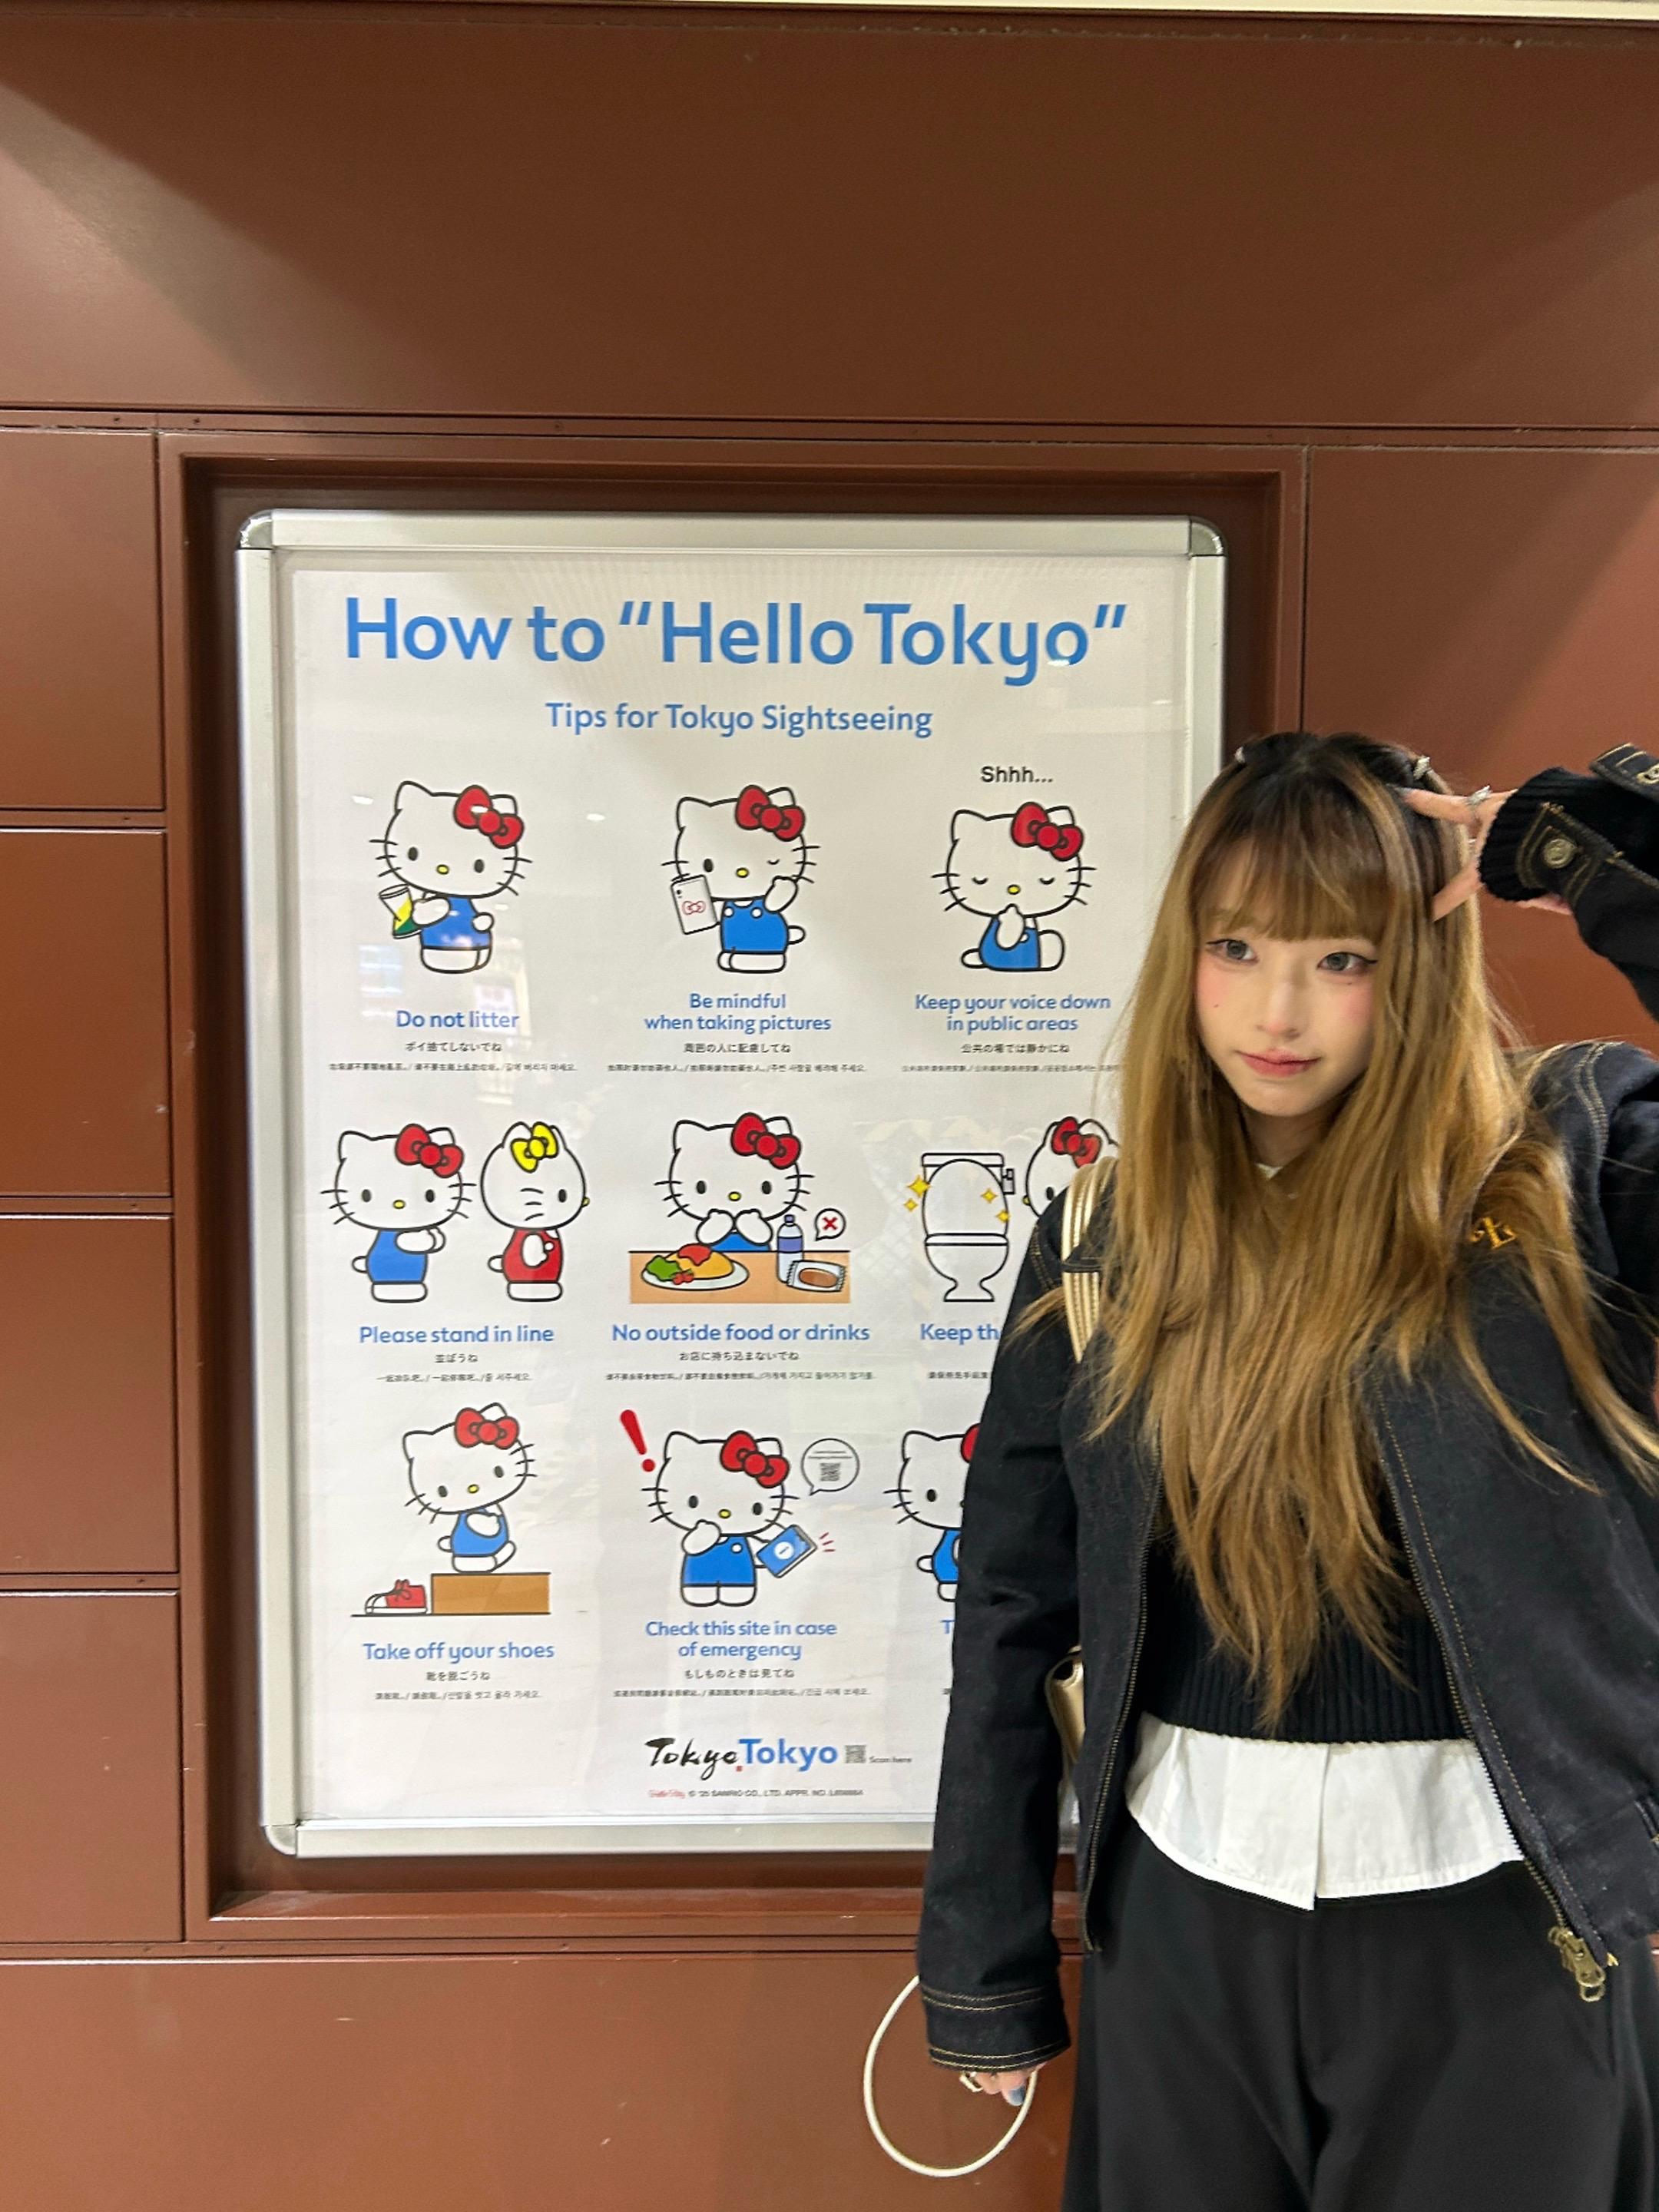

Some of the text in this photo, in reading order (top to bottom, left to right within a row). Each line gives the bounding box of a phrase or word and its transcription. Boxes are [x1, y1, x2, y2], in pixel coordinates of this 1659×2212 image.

[345, 597, 512, 661] How
[528, 607, 605, 663] to
[545, 704, 932, 737] Tips for Tokyo Sightseeing
[690, 994, 786, 1008] Be mindful
[916, 995, 1111, 1014] Keep your voice down
[396, 1011, 520, 1028] Do not litter
[644, 1015, 831, 1034] when taking pictures
[947, 1016, 1078, 1035] in public areas
[359, 1326, 554, 1343] Please stand in line
[612, 1324, 870, 1340] No outside food or drinks
[921, 1323, 999, 1345] Keep th
[646, 1621, 836, 1636] Check this site in case
[363, 1642, 554, 1664] Take off your shoes
[679, 1641, 801, 1661] of emergency
[645, 1737, 839, 1781] Tokyo Tokyo
